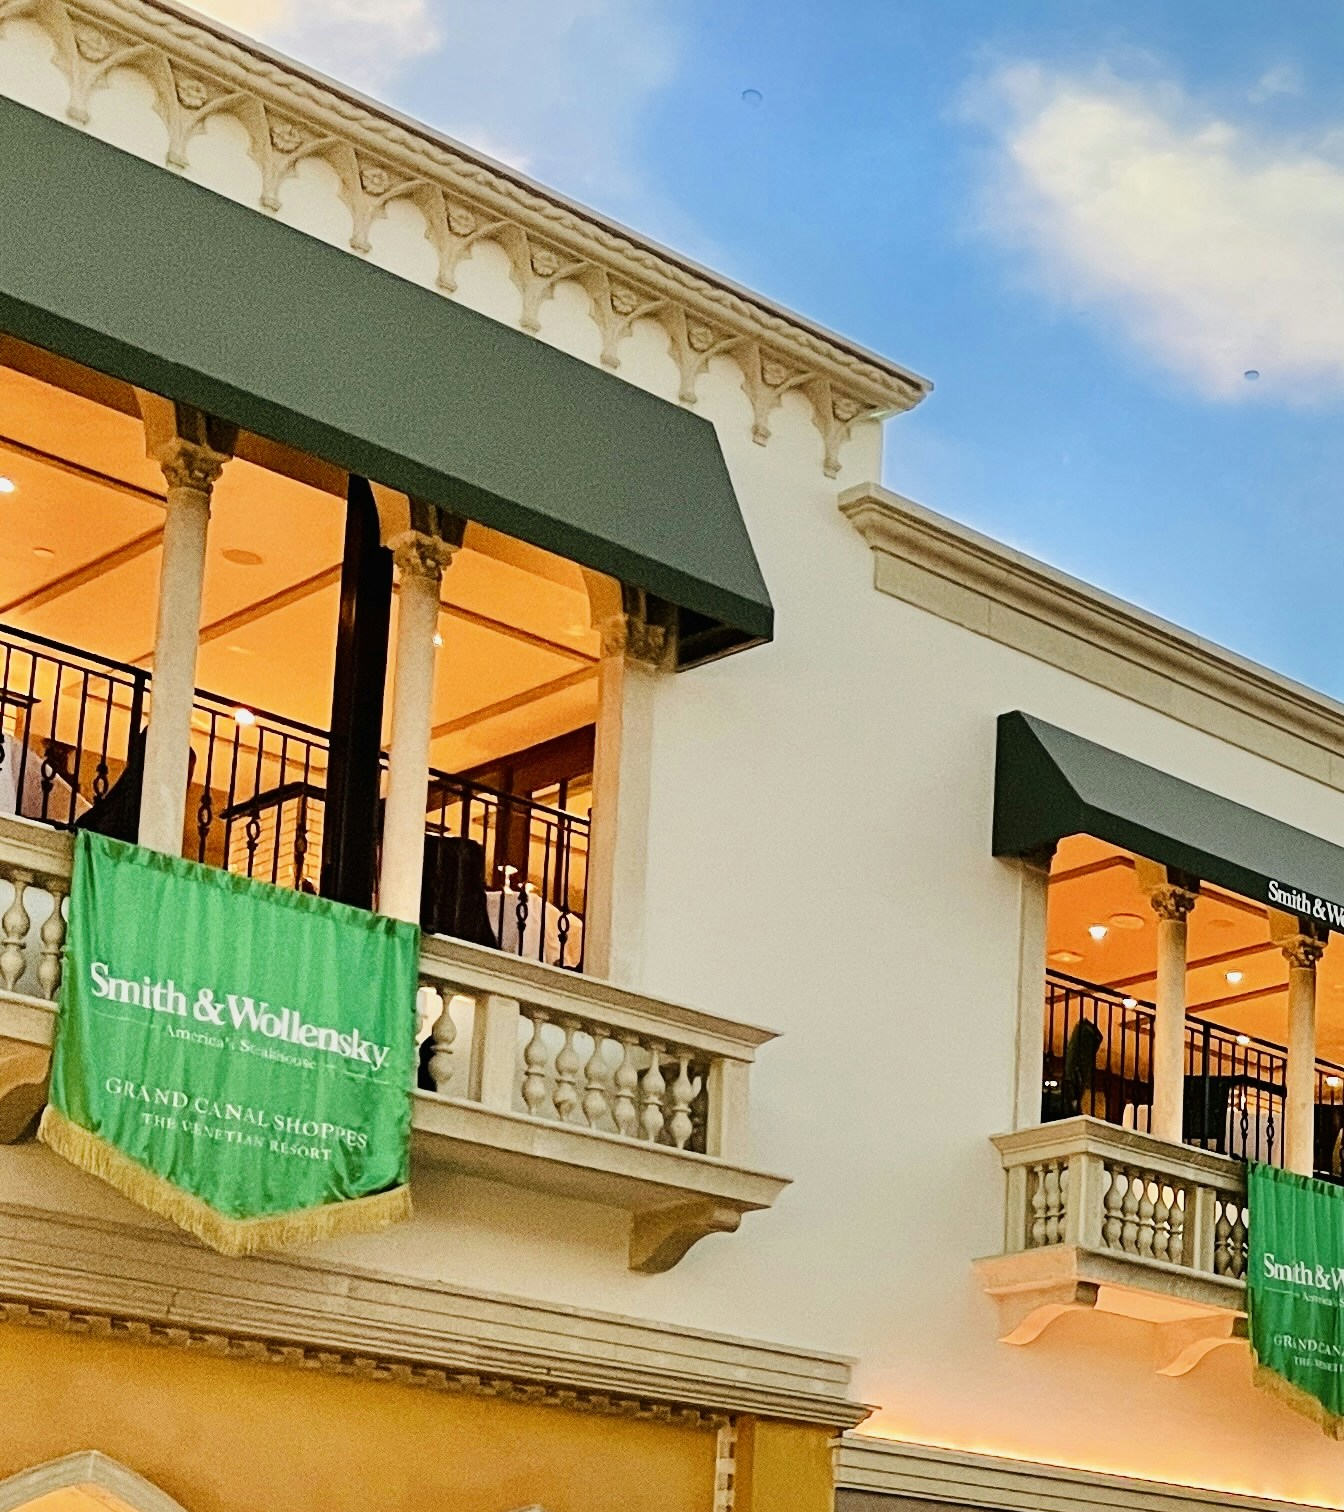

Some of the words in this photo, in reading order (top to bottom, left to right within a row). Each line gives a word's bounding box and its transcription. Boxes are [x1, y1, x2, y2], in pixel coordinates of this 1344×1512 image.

[1268, 880, 1311, 915] Smith
[1312, 898, 1327, 921] &
[91, 961, 188, 1017] Smith
[192, 988, 226, 1026] &
[225, 994, 391, 1072] Wollensky
[105, 1077, 189, 1109] GRAND
[194, 1097, 270, 1128] CANAL
[273, 1114, 369, 1150] SHOPPES
[141, 1112, 177, 1130] THE
[181, 1119, 265, 1148] VENETIAN
[269, 1139, 332, 1161] RESORT
[1263, 1252, 1315, 1287] Smith
[1315, 1264, 1331, 1291] &
